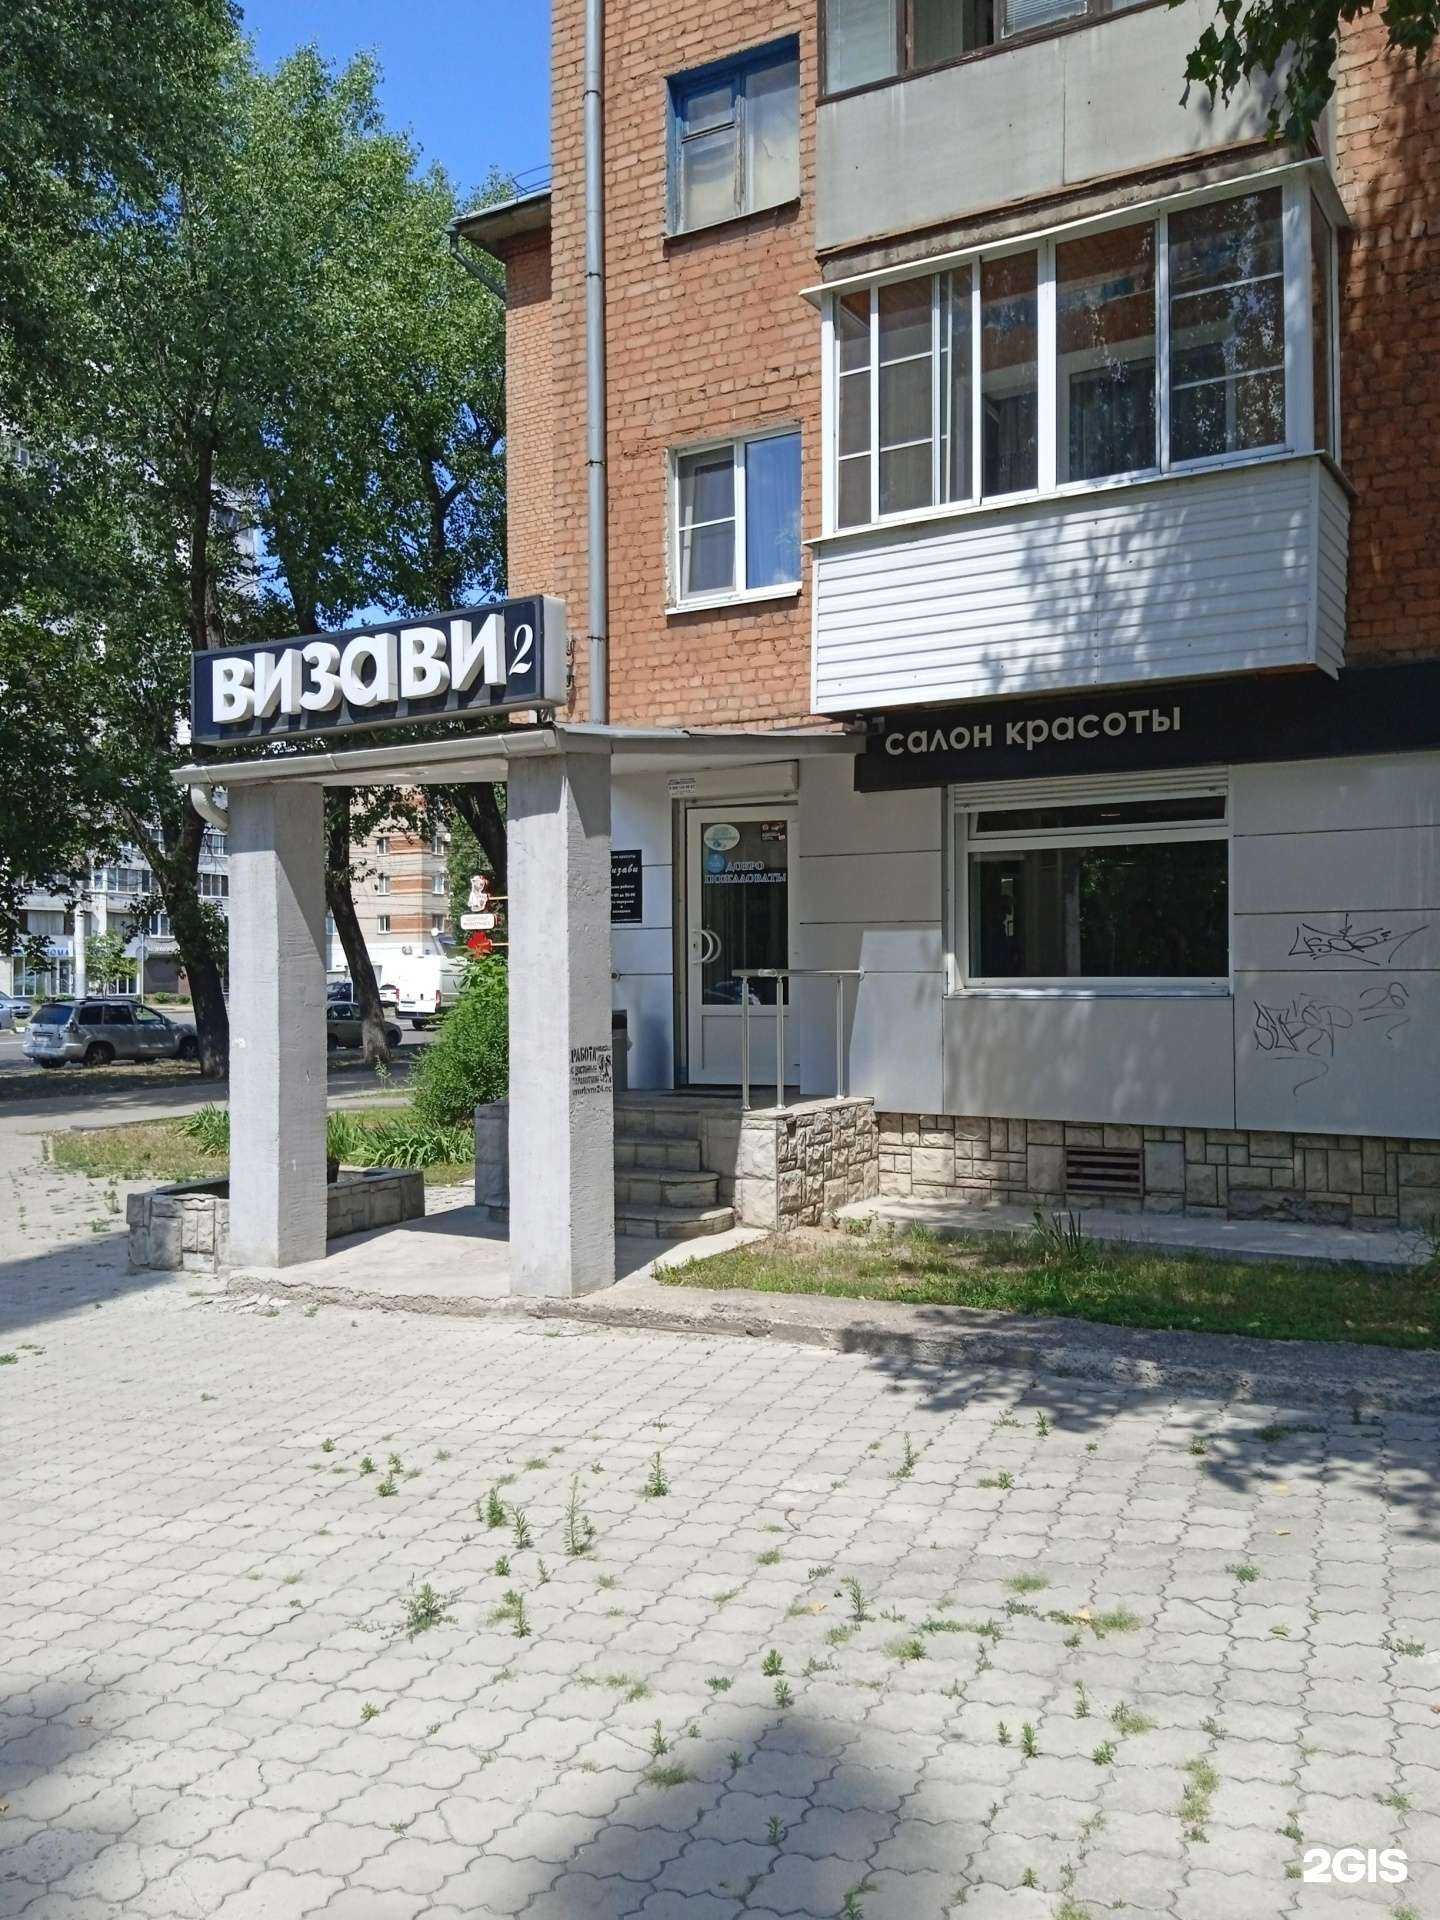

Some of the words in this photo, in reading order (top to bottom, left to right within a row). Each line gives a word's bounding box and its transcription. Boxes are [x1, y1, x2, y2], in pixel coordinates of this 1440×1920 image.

[509, 623, 534, 676] 2
[885, 723, 993, 756] салон
[1005, 706, 1181, 751] красоты
[610, 863, 638, 877] изави
